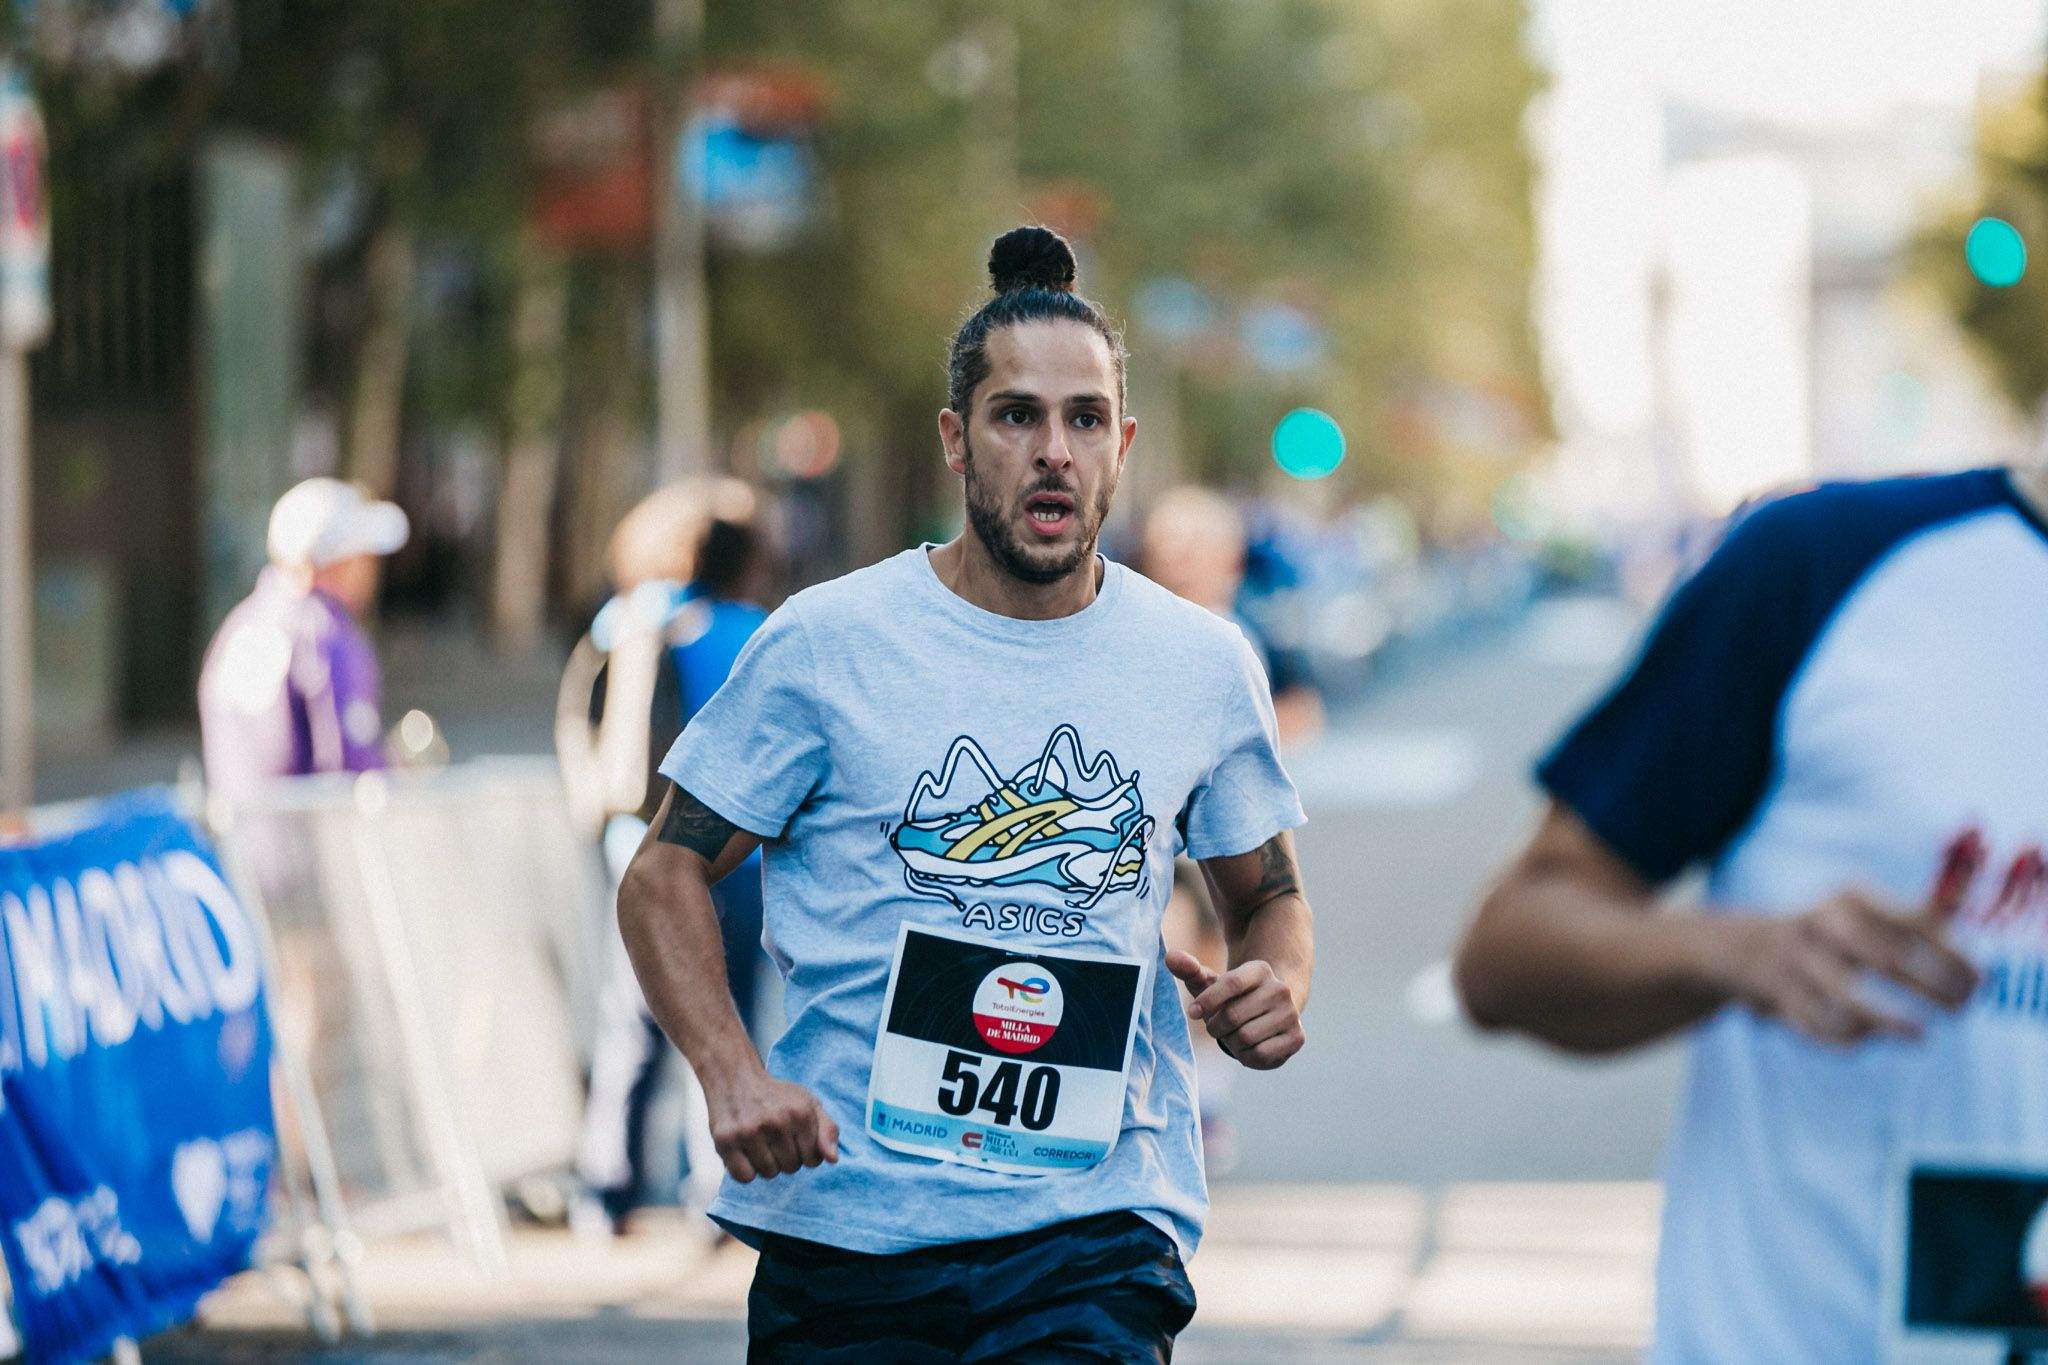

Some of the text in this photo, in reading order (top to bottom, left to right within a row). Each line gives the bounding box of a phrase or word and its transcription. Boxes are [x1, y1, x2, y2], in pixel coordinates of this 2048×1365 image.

[963, 903, 1086, 937] ASICS
[986, 1027, 1041, 1044] DE MADRID
[1000, 1020, 1031, 1034] MILLA
[937, 1049, 1061, 1131] 540
[892, 1118, 948, 1139] MADRID
